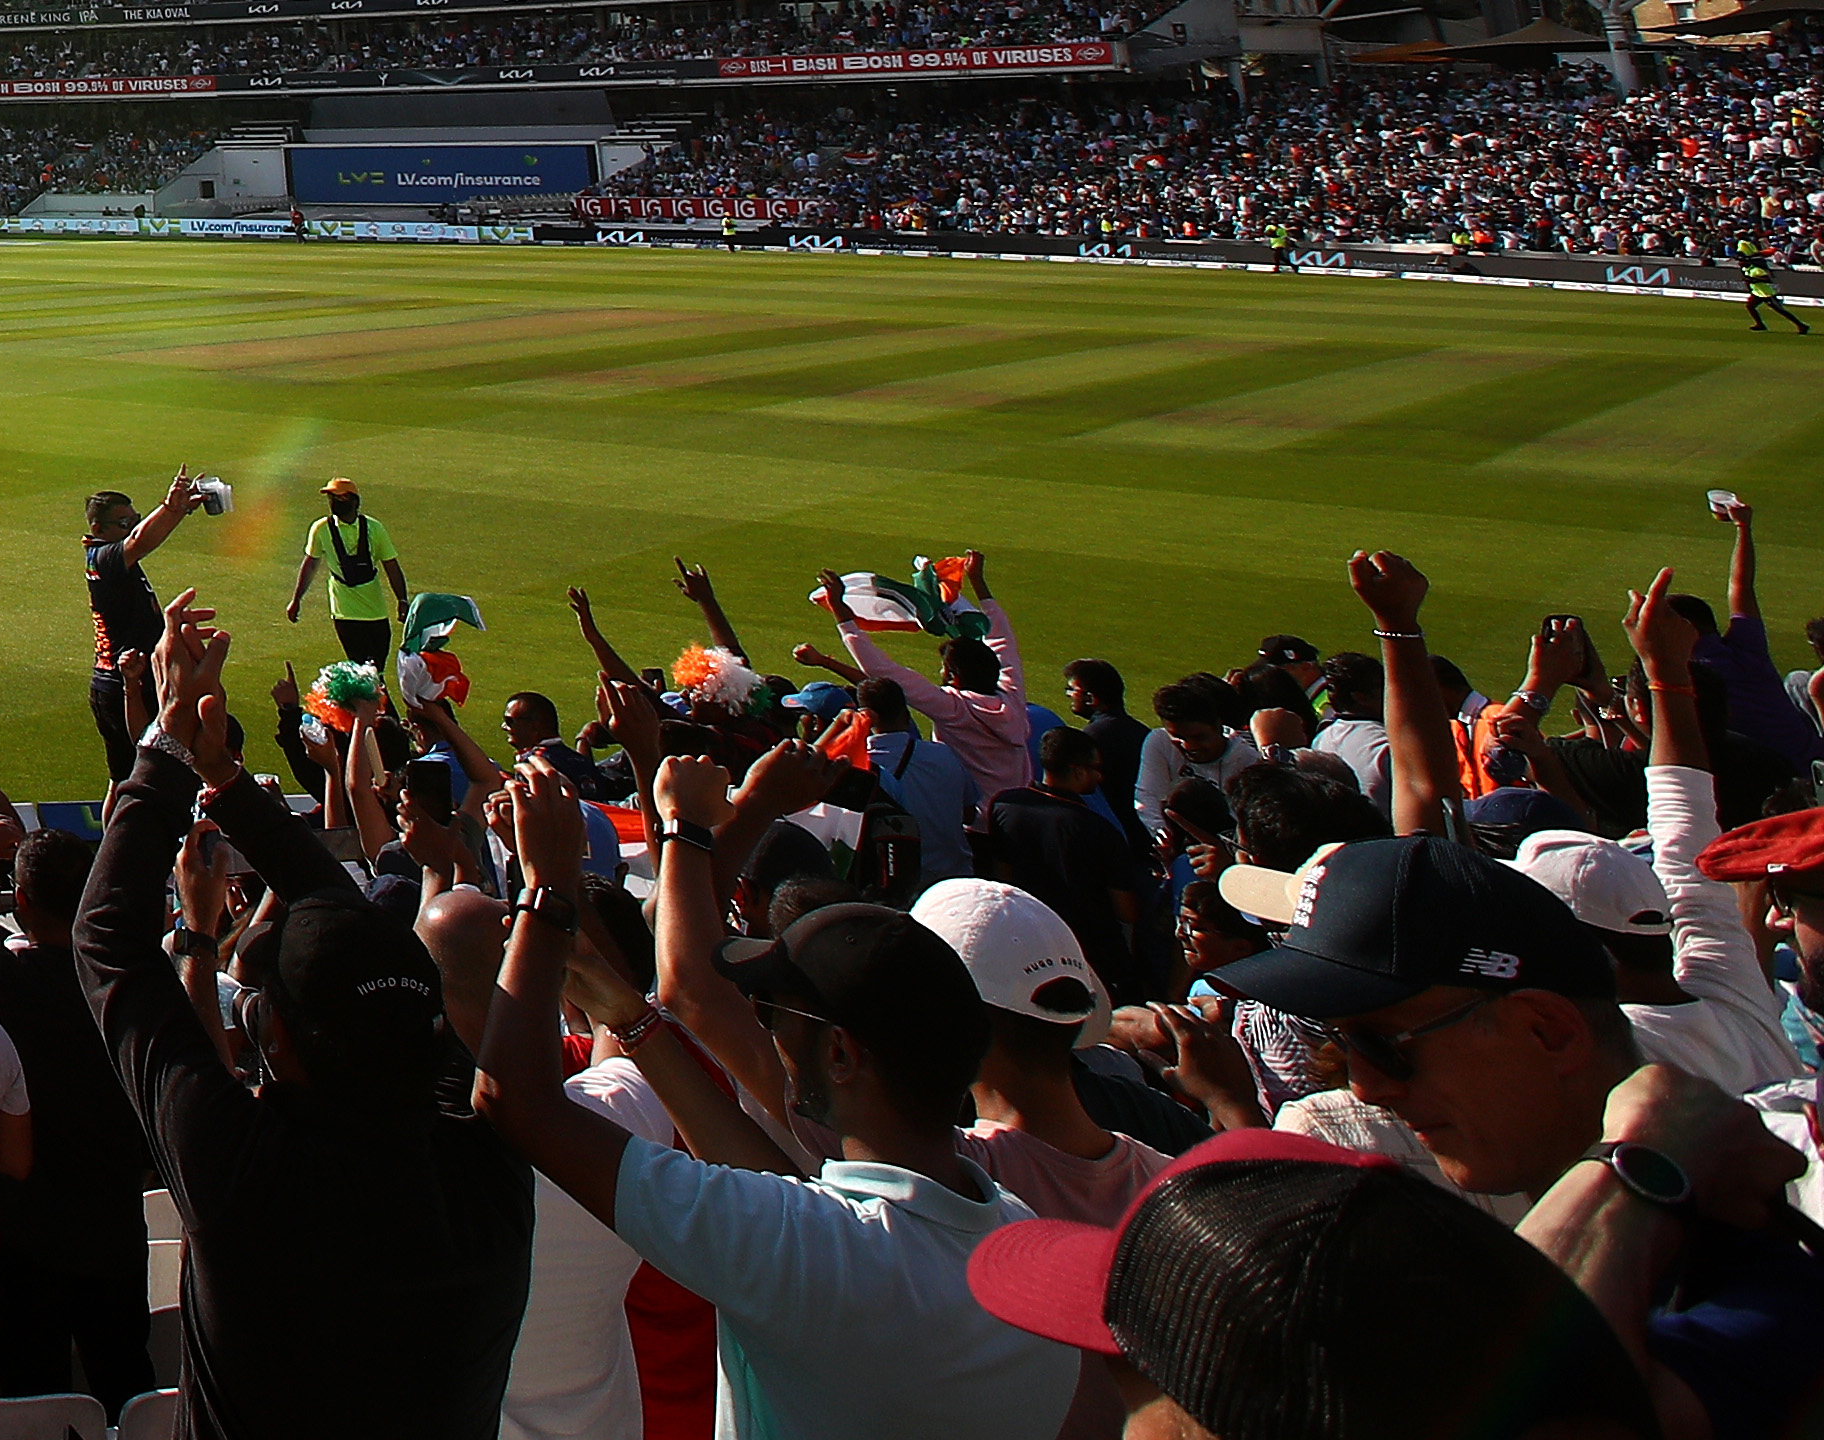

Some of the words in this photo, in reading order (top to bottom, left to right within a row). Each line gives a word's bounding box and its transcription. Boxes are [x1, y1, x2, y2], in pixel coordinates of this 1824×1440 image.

[40, 12, 71, 23] KING
[79, 10, 99, 24] IPA
[123, 9, 143, 20] THE
[146, 9, 163, 19] KIA
[165, 7, 190, 19] OVAL
[750, 59, 787, 73] BISH
[792, 58, 837, 72] BASH
[842, 56, 902, 70] BOSH
[908, 53, 967, 67] 99.9%
[973, 51, 988, 65] OF
[992, 48, 1072, 64] VIRUSES
[13, 81, 60, 94] BOSH
[65, 80, 109, 93] 99.9%
[112, 79, 125, 91] OF
[128, 77, 188, 91] VIRUSES
[397, 172, 541, 188] LV.com/insurance
[672, 200, 693, 216] IG
[703, 200, 724, 216] IG
[734, 200, 755, 217] IG
[190, 220, 290, 234] LV.com/insuran
[789, 234, 843, 248] KIA
[1289, 248, 1346, 266] KIA
[1605, 266, 1670, 286] KIA
[1023, 959, 1053, 976] HUGO
[357, 977, 397, 995] HUGO
[400, 977, 430, 996] BOSS
